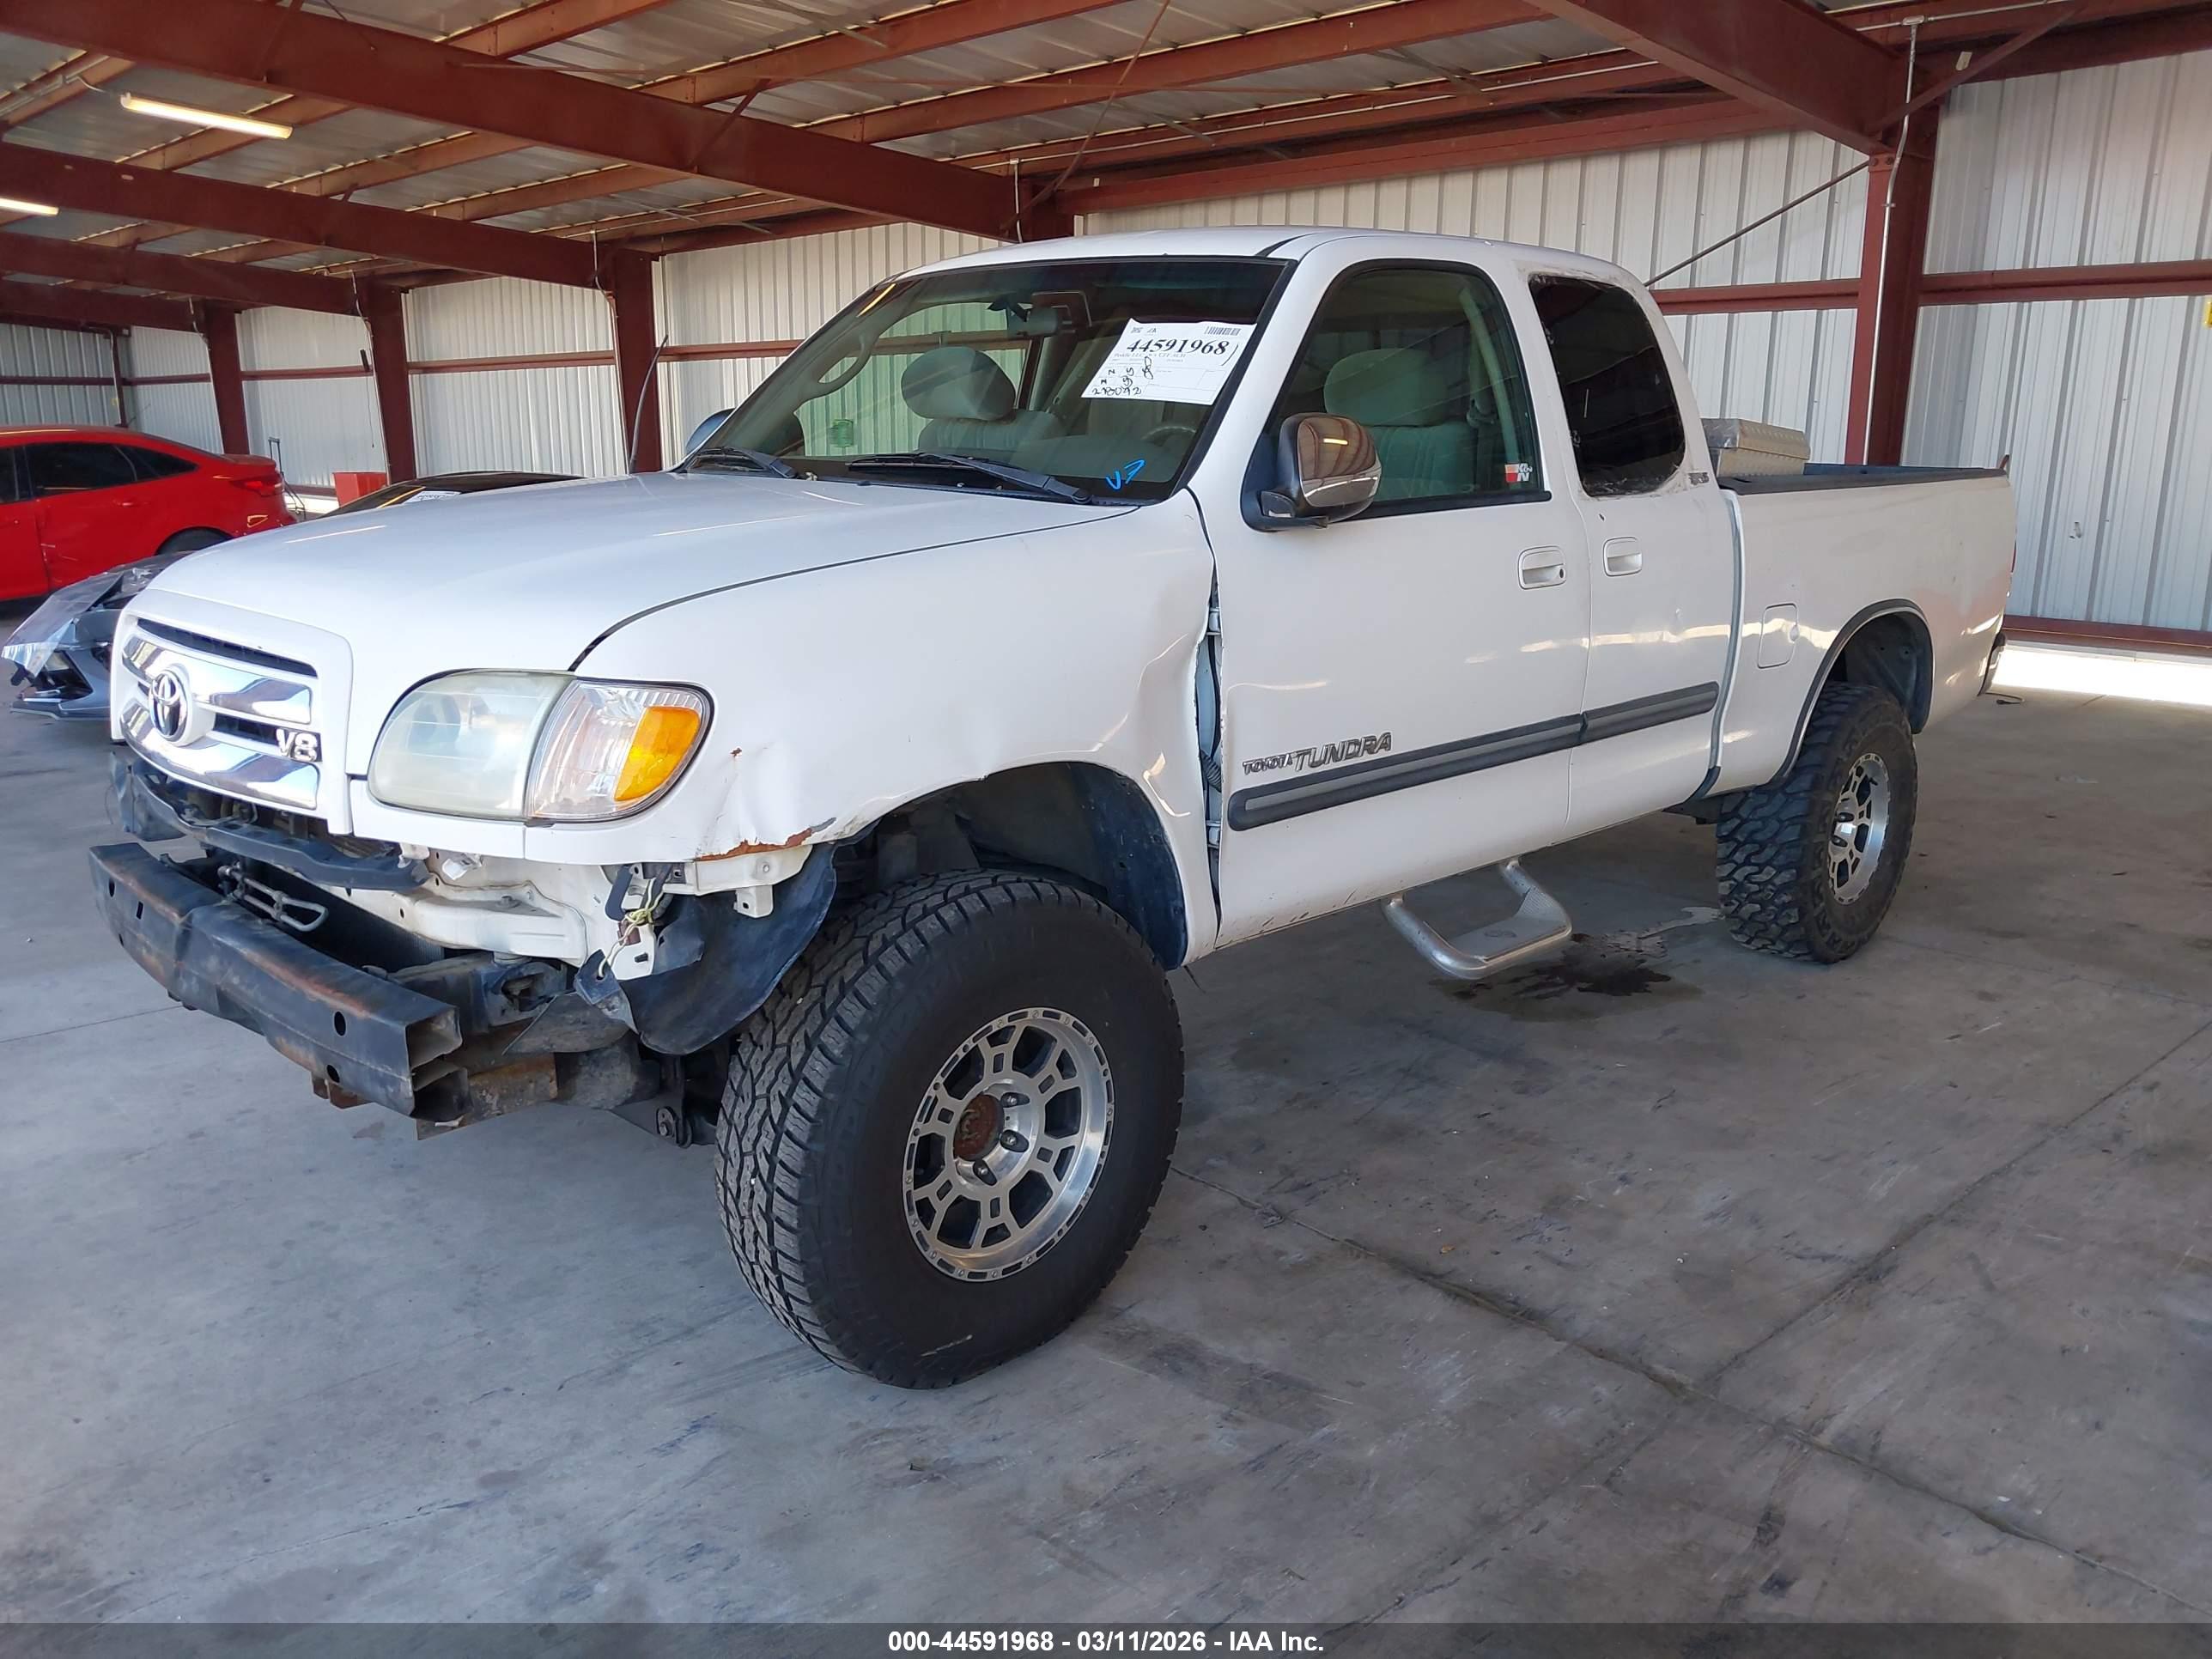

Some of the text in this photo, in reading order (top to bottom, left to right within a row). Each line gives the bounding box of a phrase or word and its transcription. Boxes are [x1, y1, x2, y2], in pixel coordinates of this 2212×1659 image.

[1126, 338, 1230, 355] 44591968
[276, 728, 319, 762] V8
[1243, 732, 1393, 775] TOYOTA TUNDRA
